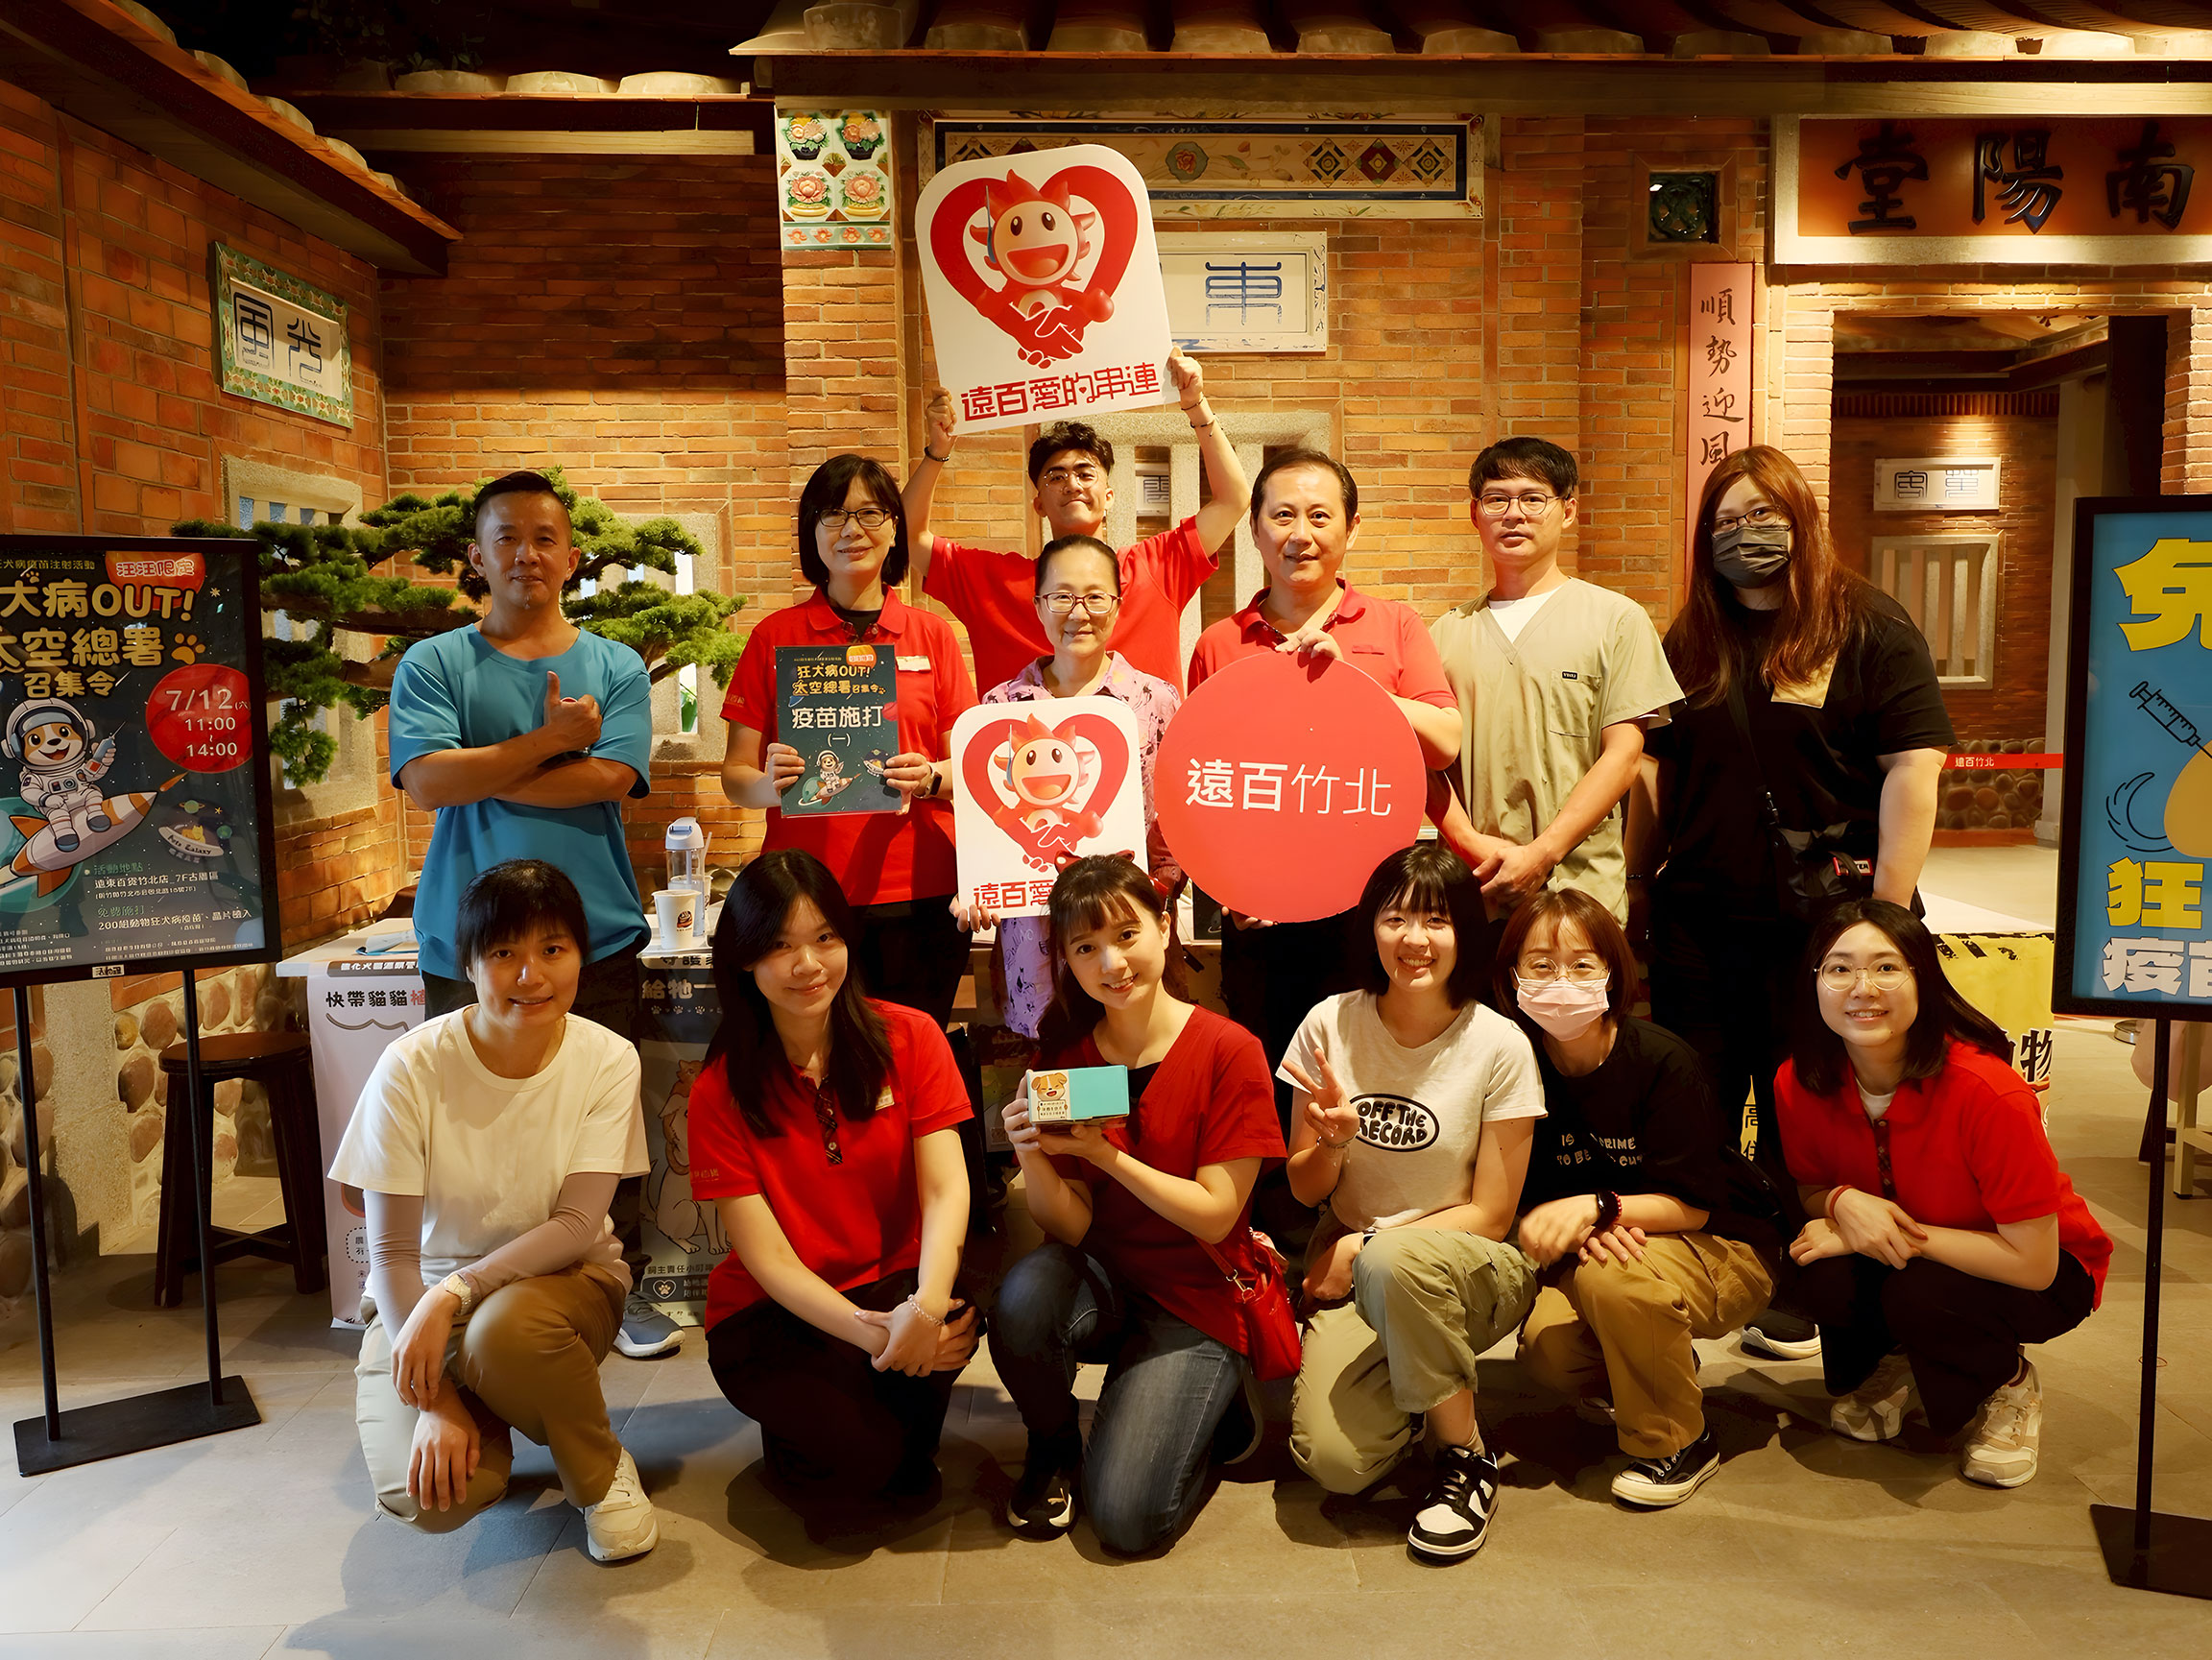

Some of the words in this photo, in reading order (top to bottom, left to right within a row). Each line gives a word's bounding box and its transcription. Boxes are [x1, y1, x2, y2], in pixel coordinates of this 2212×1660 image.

[1700, 288, 1743, 466] 順勢迎風
[961, 362, 1160, 421] 遠百愛的串連
[0, 559, 95, 570] 犬病疫苗注射活動
[116, 560, 195, 577] 汪汪限定
[24, 671, 116, 698] 召集令
[797, 663, 871, 679] 狂犬病OUT!
[165, 688, 232, 711] 7/12
[185, 717, 236, 732] 11:00
[791, 706, 883, 730] 疫苗施打
[187, 742, 237, 757] 14:00
[1955, 757, 1995, 767] 遠百竹北
[1186, 758, 1391, 816] 遠百竹北
[974, 879, 1055, 909] 遠百愛
[2105, 856, 2204, 929] 狂
[2102, 937, 2212, 996] 疫
[1357, 1100, 1395, 1121] OFF
[1397, 1104, 1427, 1127] THE
[1359, 1118, 1428, 1145] RECORD
